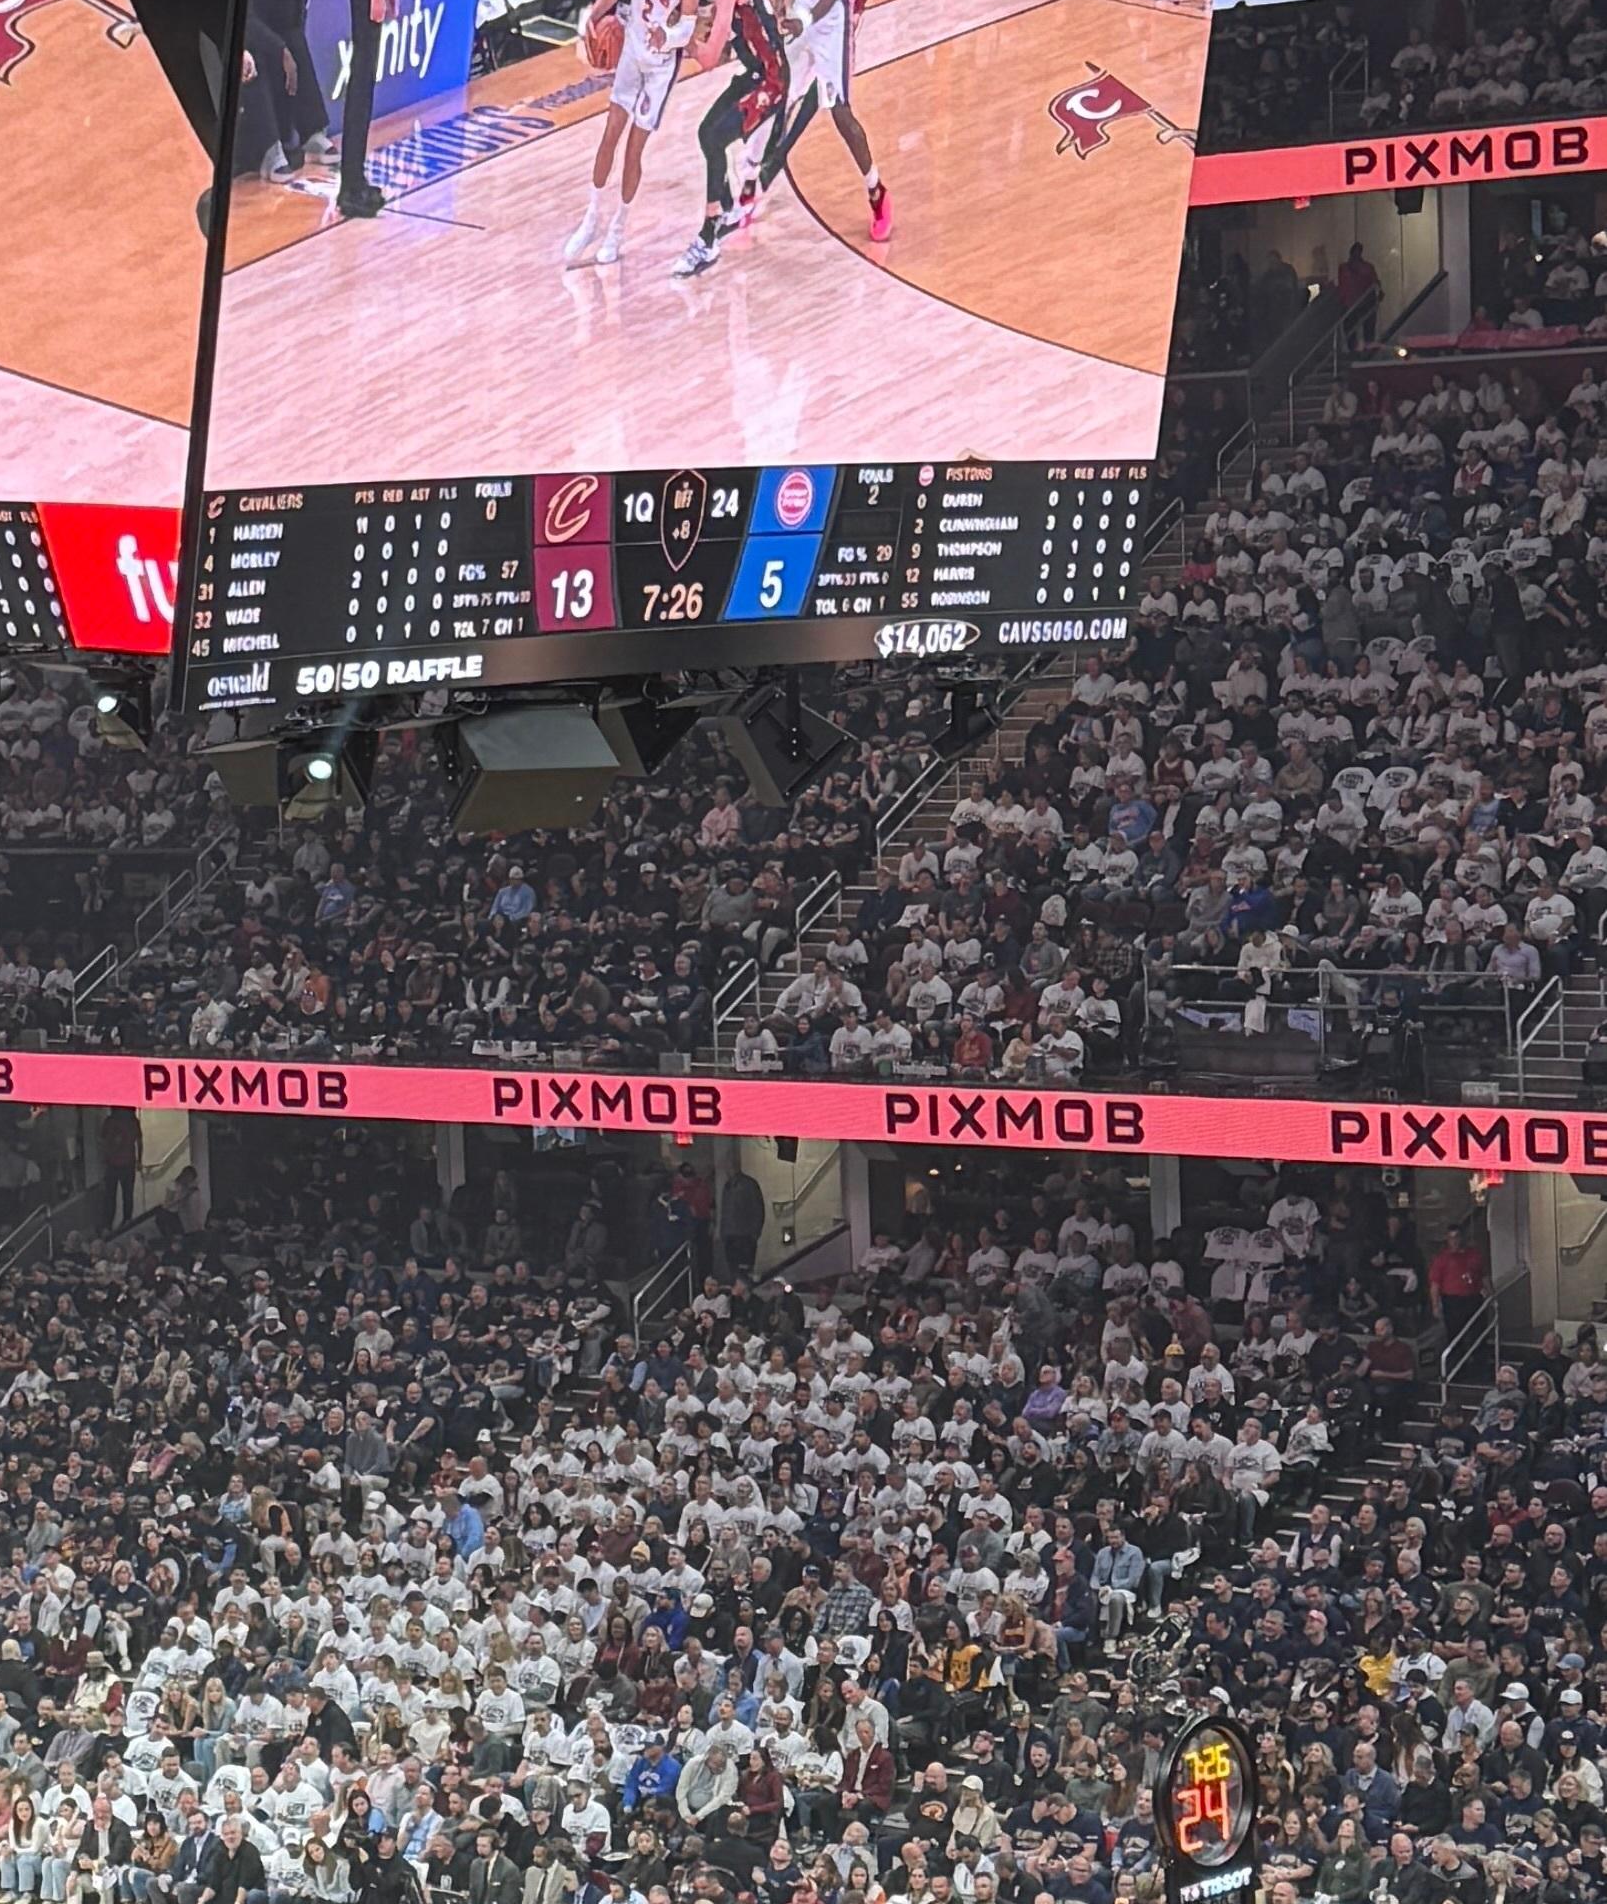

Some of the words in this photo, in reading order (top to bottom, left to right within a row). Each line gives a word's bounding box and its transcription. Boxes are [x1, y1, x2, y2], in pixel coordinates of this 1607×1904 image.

[1345, 126, 1589, 185] PIXMOB
[239, 493, 303, 512] CAVALIERS
[623, 492, 654, 523] 1Q
[711, 488, 739, 518] 24
[551, 569, 594, 619] 13
[760, 560, 784, 608] 5
[901, 593, 918, 608] 55
[644, 582, 703, 622] 7:26
[878, 623, 968, 658] $14,062
[999, 617, 1127, 643] CAVS5050.COM
[387, 654, 484, 685] RAFFLE
[144, 1064, 348, 1109] PIXMOB
[494, 1077, 723, 1127] PIXMOB
[885, 1093, 1145, 1145] PIXMOB
[1185, 1744, 1230, 1781] 7:26
[1177, 1781, 1229, 1854] 24
[1203, 1868, 1252, 1897] TISSOT
